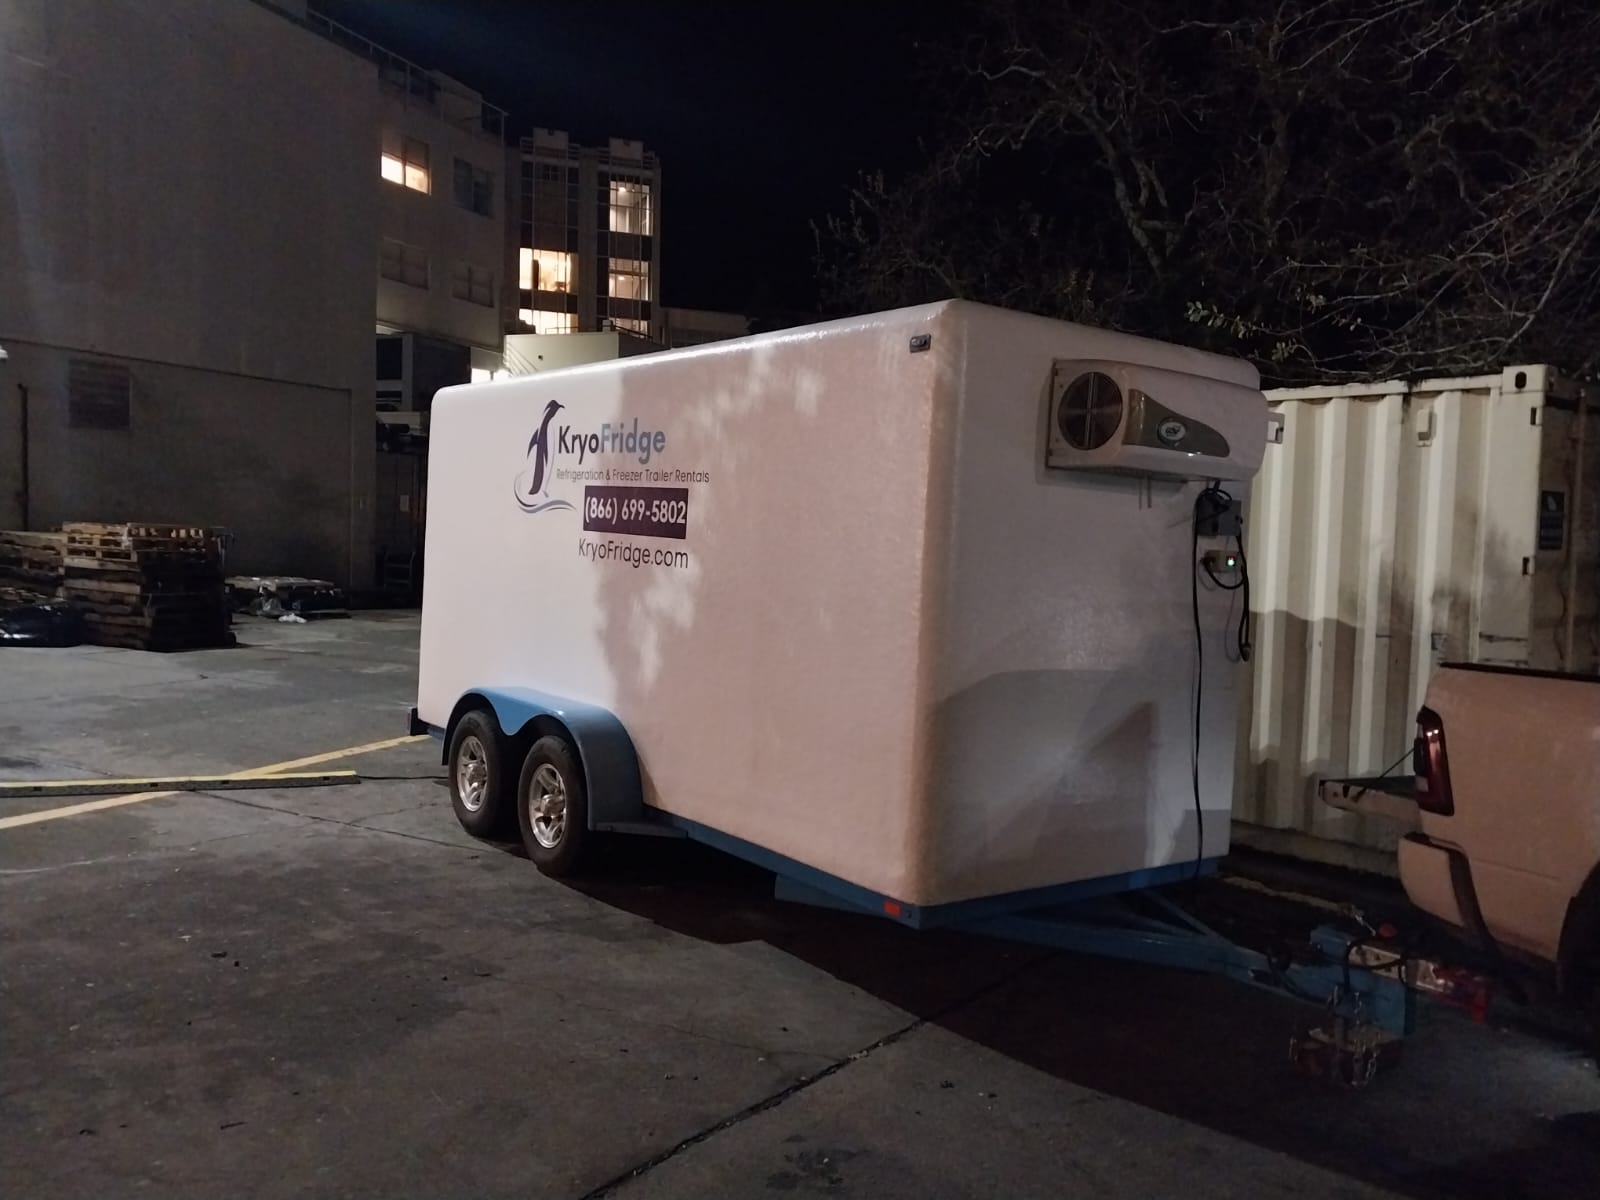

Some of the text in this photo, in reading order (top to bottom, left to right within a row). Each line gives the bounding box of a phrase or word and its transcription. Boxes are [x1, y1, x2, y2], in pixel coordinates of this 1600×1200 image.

[558, 417, 666, 465] KryoFridge
[556, 468, 710, 483] Refrigeration & Freezer Trailer Rentals
[585, 496, 686, 525] (866) 699-5802
[578, 537, 689, 569] KryoFridge.com
